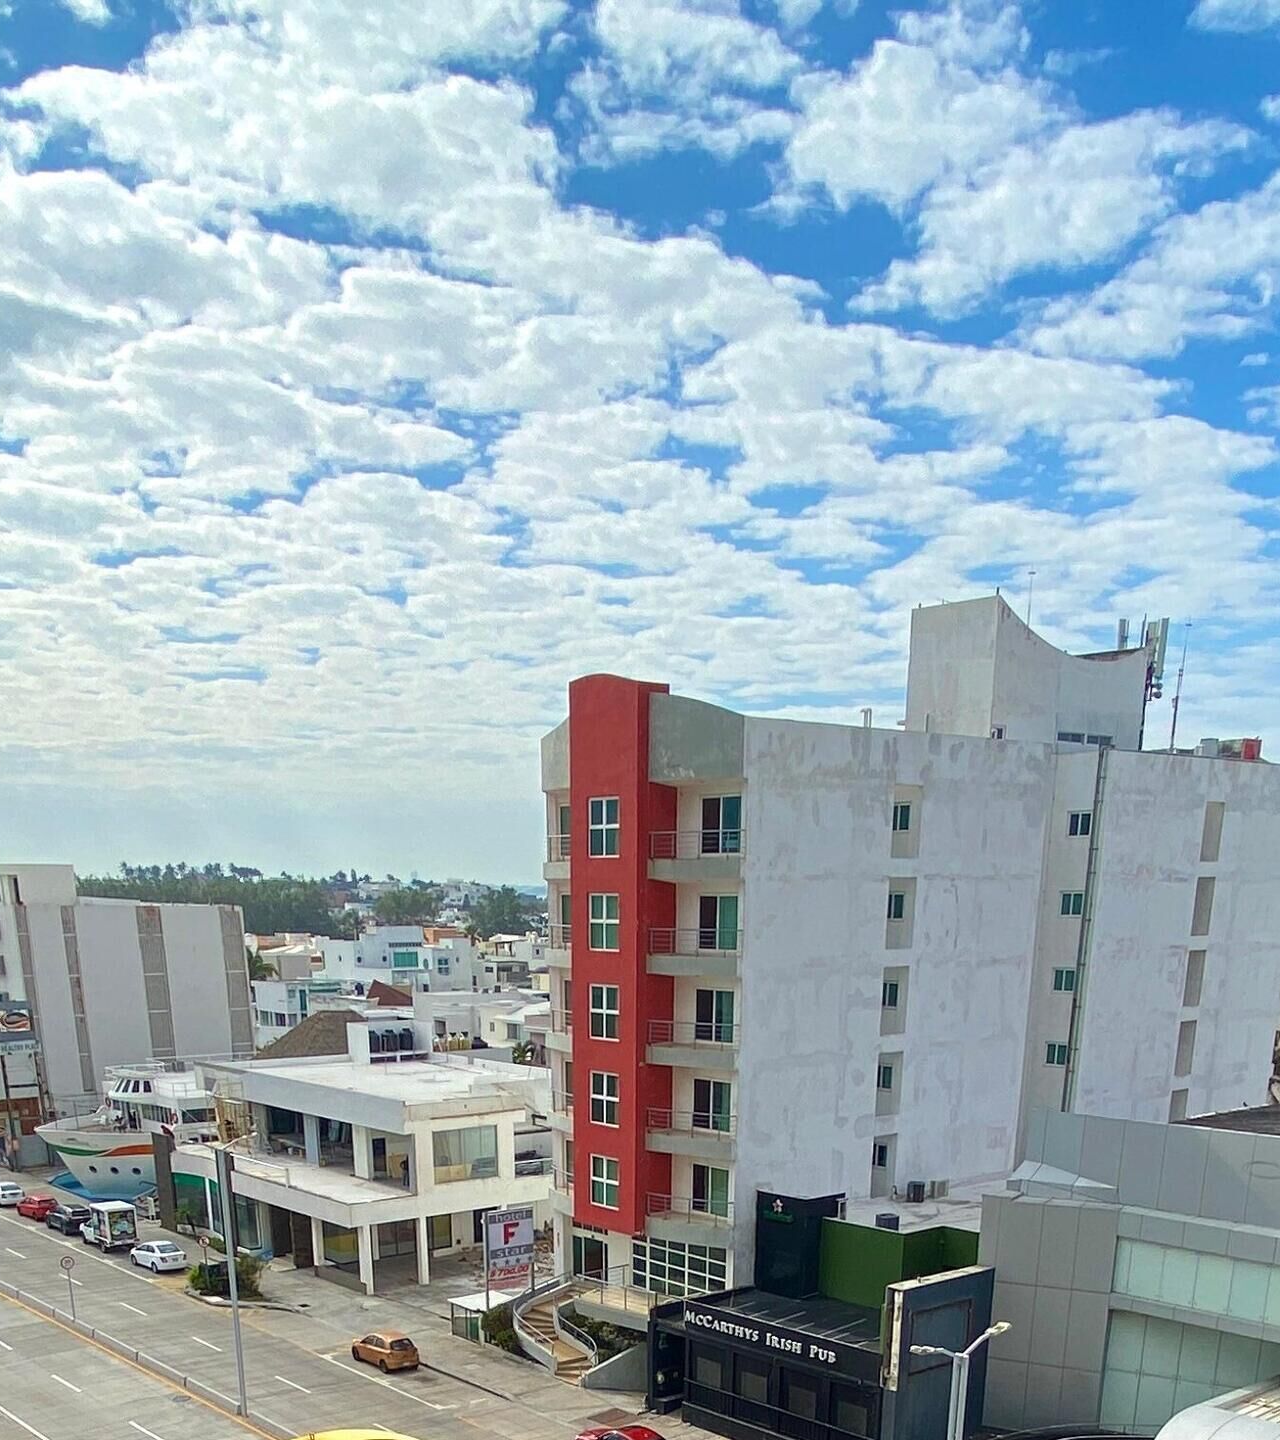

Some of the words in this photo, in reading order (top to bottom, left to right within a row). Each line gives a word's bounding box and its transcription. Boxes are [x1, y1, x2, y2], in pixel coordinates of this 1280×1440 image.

[495, 1212, 527, 1222] hotel
[503, 1222, 520, 1245] F
[496, 1246, 527, 1258] star
[765, 1333, 802, 1354] IRISH
[809, 1345, 837, 1363] PUB
